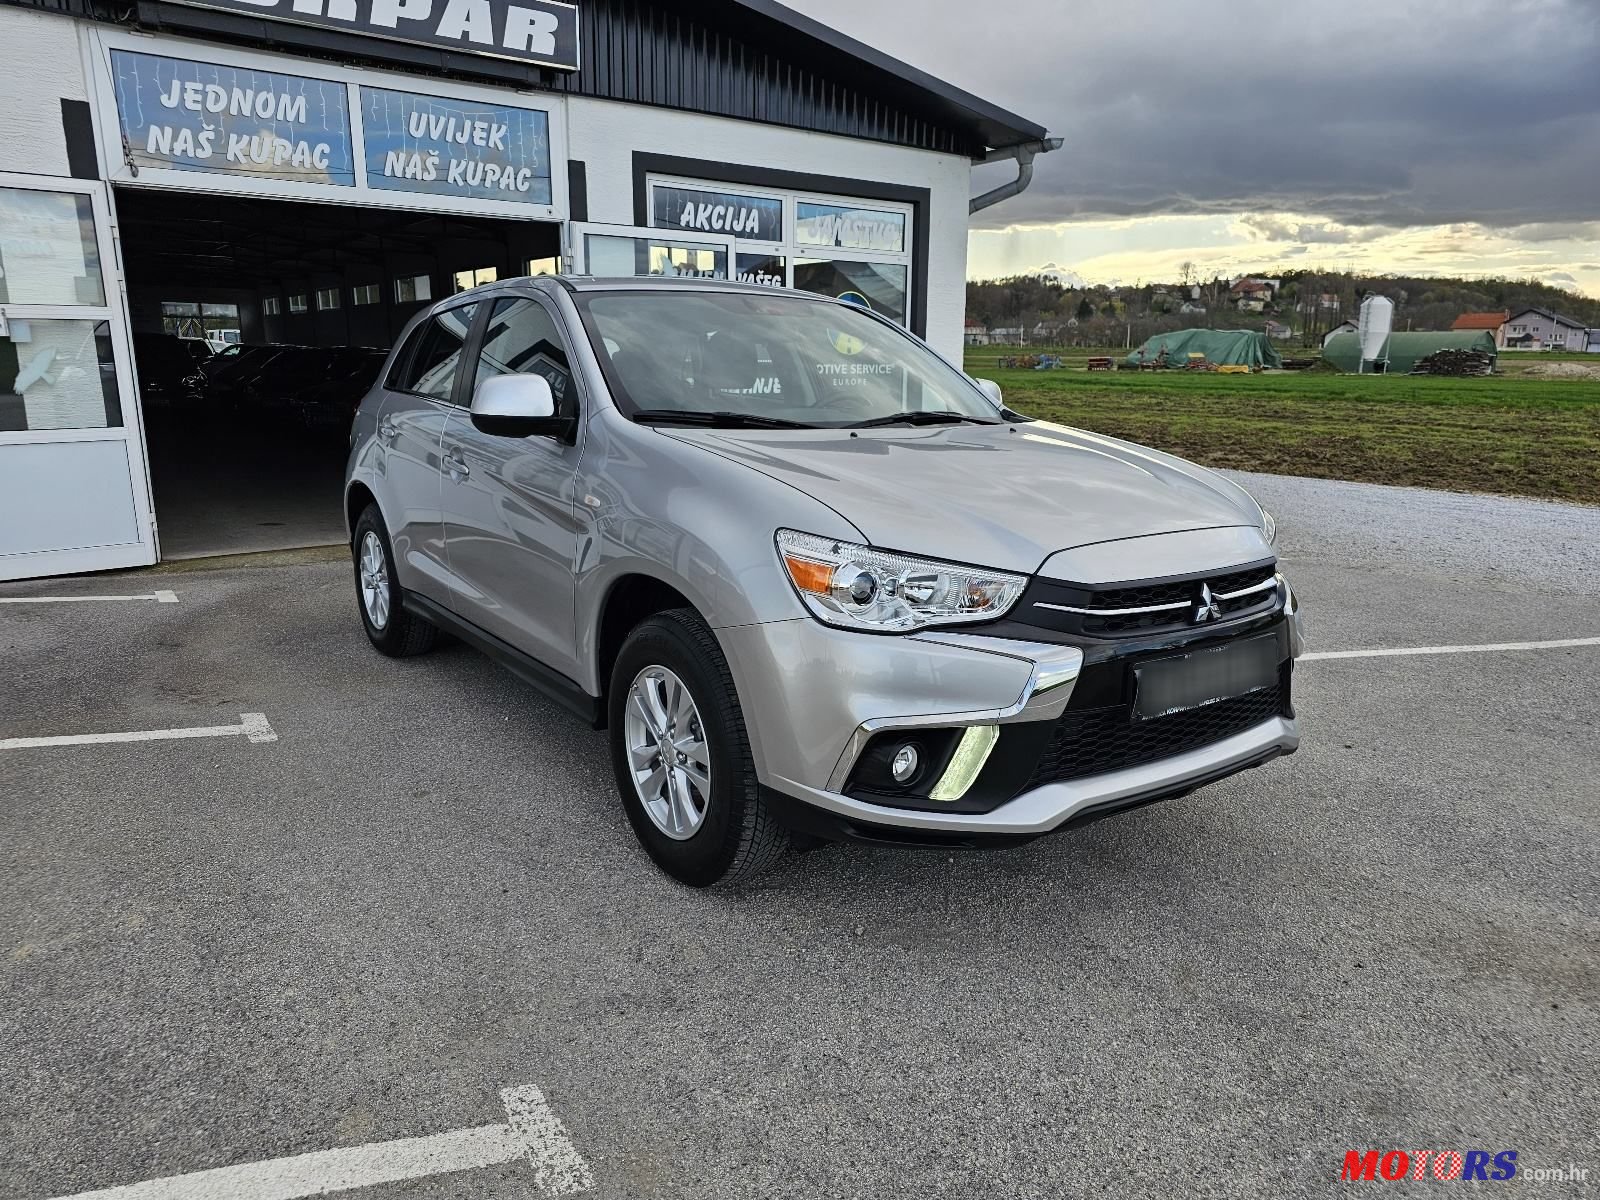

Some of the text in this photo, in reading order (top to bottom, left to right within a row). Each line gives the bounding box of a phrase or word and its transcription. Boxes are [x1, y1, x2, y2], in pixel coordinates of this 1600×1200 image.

[233, 0, 559, 56] PAR
[160, 79, 307, 124] JEDNOM
[146, 123, 330, 171] NAŠ KUPAC
[408, 111, 508, 151] UVIJEK
[384, 150, 532, 193] NAŠ KUPAC
[680, 202, 759, 234] AKCIJA
[833, 378, 867, 386] EUROPE
[850, 363, 892, 375] SERVICE
